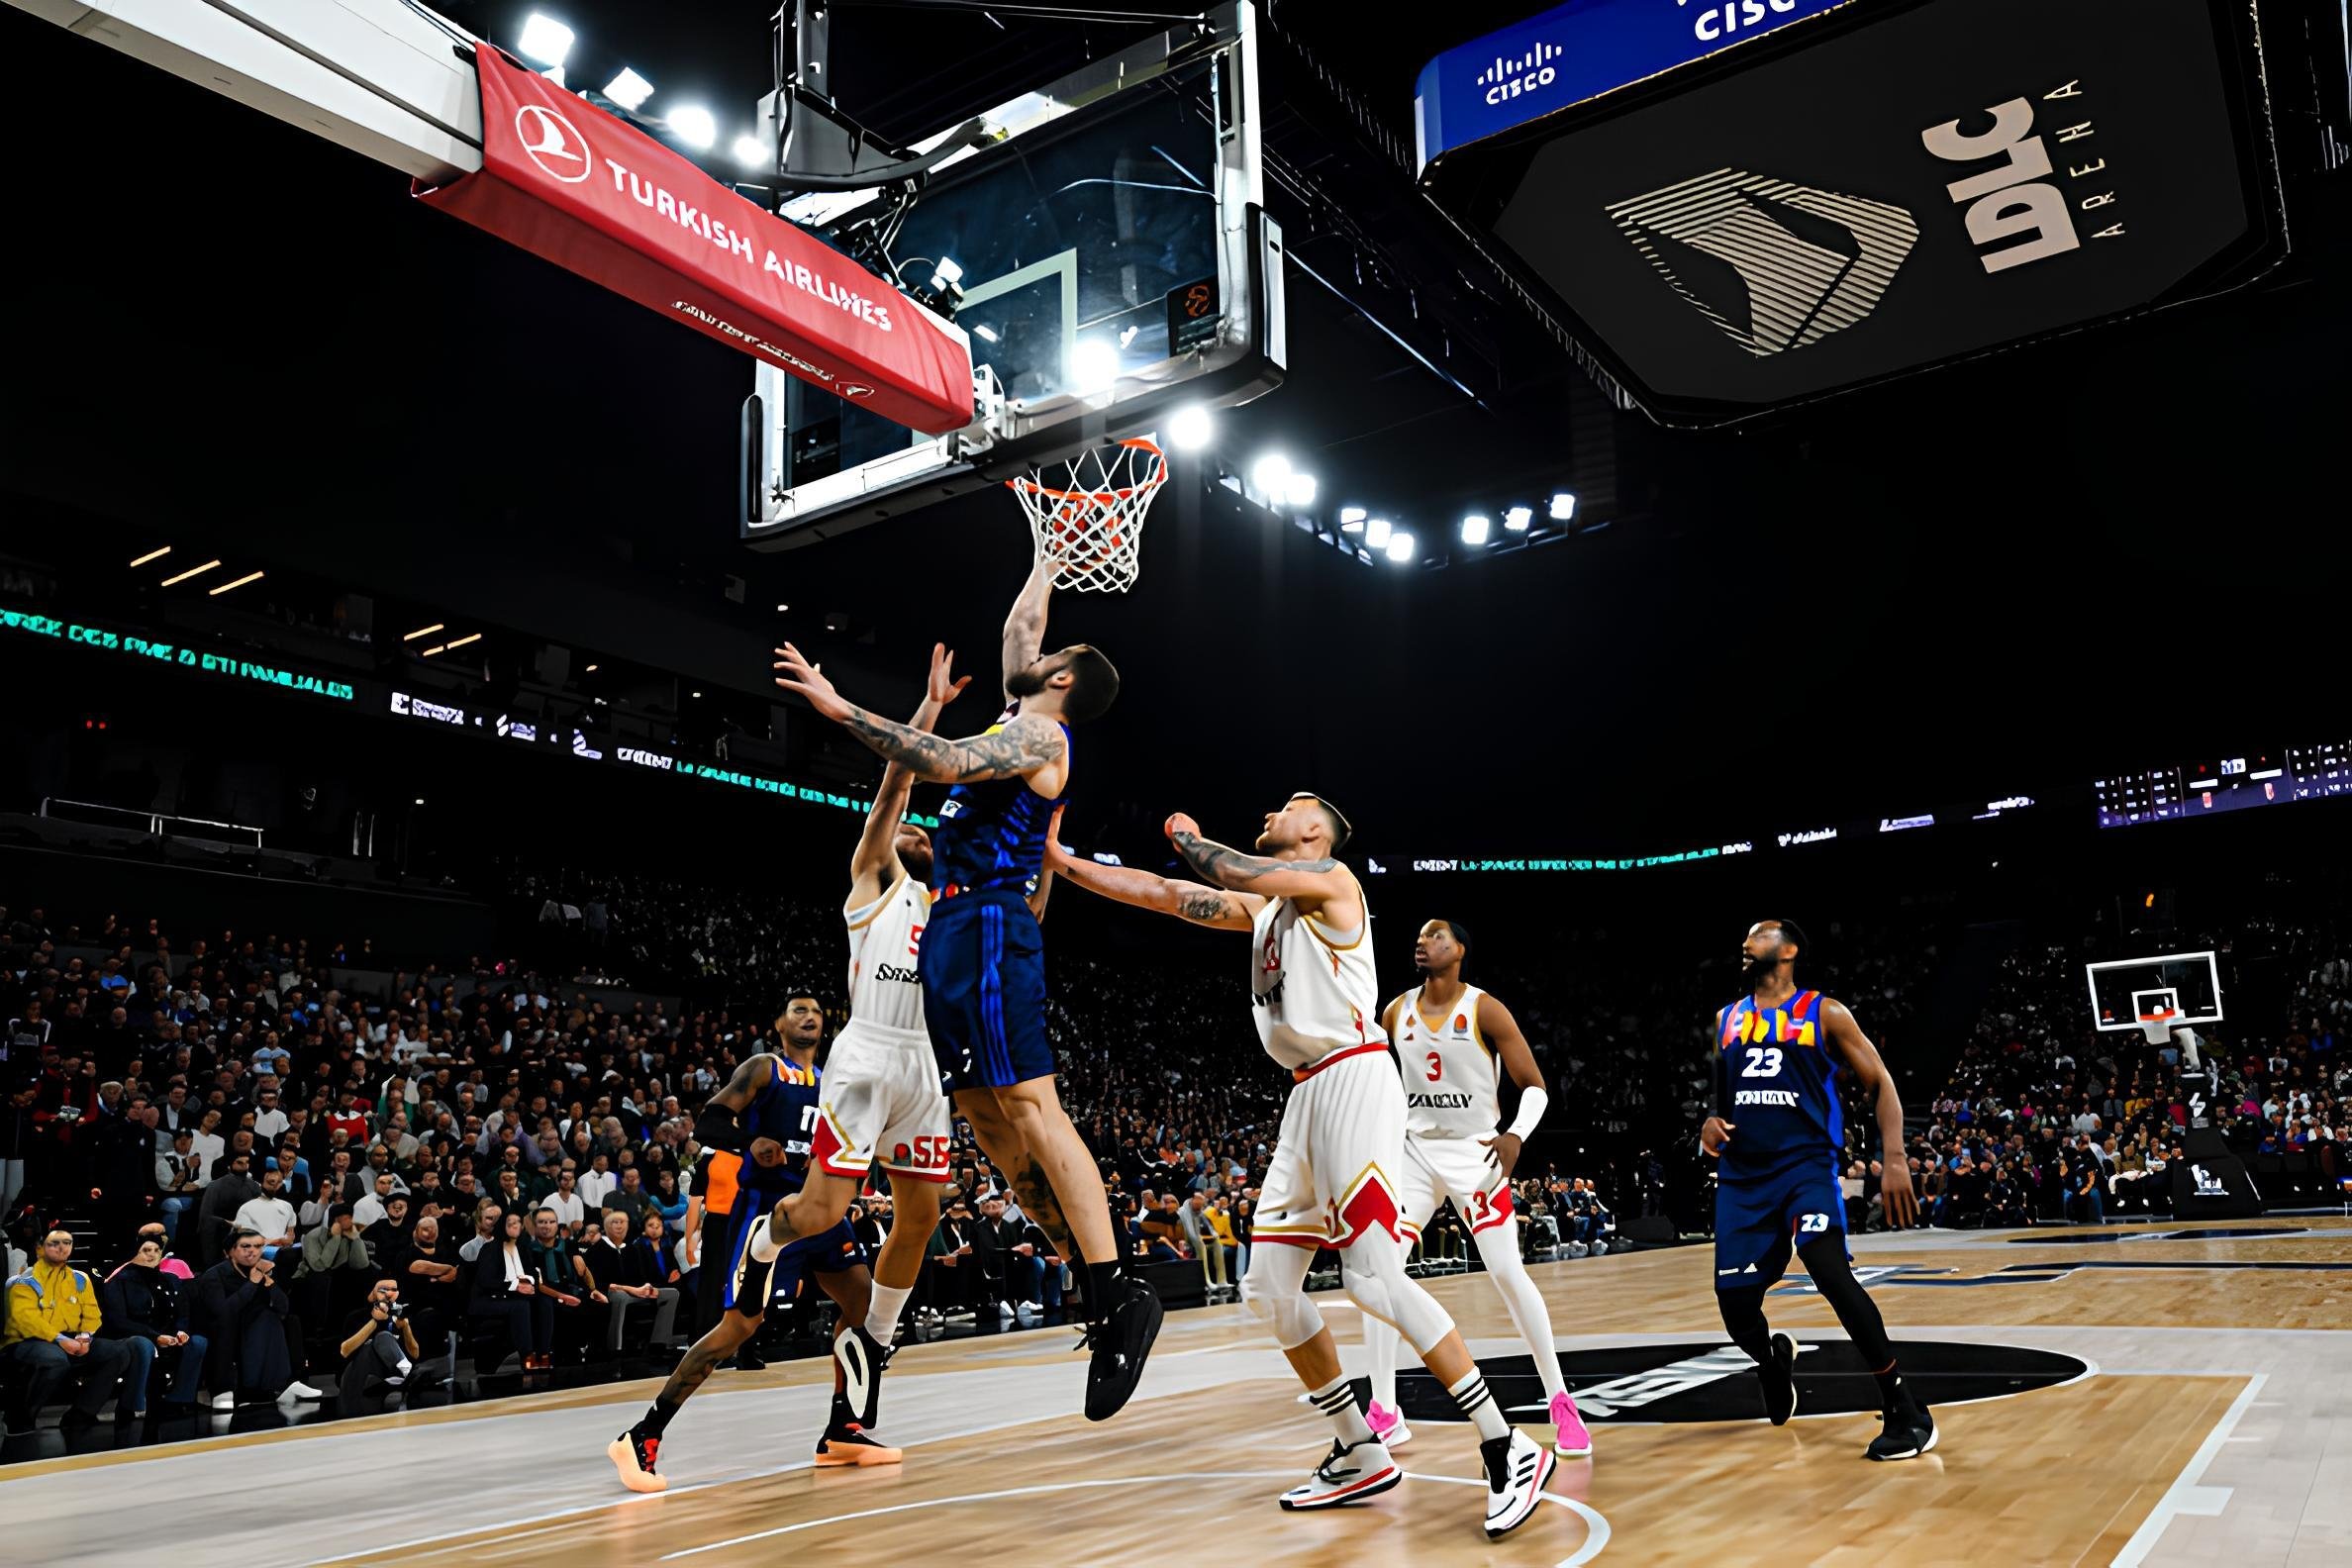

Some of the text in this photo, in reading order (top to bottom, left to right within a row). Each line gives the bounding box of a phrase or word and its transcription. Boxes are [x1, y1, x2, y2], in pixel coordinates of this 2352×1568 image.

[1485, 66, 1556, 105] CISCO
[1921, 96, 2081, 274] LDLC
[605, 157, 892, 333] TURKISH AIRLINES
[1426, 1051, 1442, 1082] 3
[1741, 1047, 1784, 1078] 23
[1801, 1213, 1829, 1233] 23
